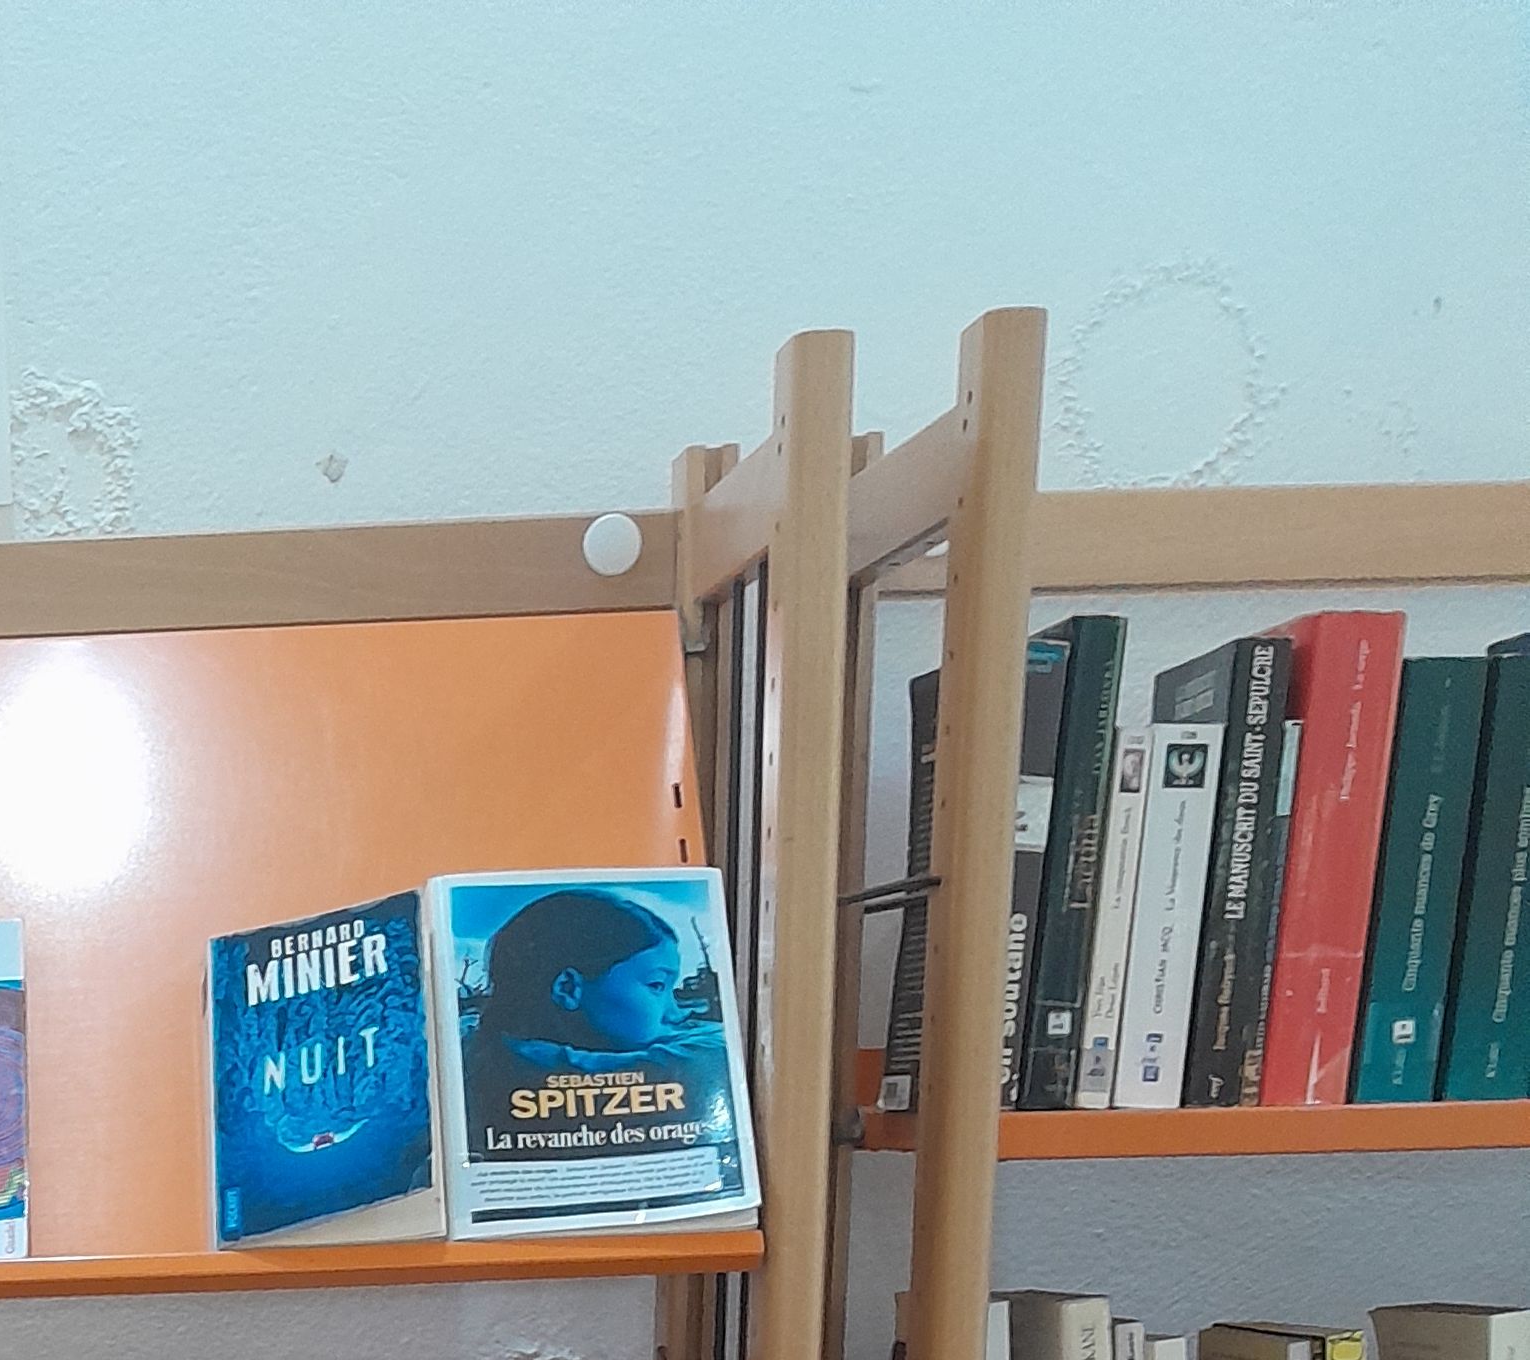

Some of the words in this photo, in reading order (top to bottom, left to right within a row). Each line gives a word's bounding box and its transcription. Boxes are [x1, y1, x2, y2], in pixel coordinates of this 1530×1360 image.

[1242, 777, 1260, 809] DU
[1227, 812, 1257, 895] MANUSCRIT
[1224, 893, 1245, 920] LE
[270, 919, 365, 958] BERNARD
[245, 933, 389, 1008] MINIER
[264, 1027, 380, 1096] NUIT
[511, 1083, 686, 1119] SPITZER
[487, 1127, 512, 1151] La
[517, 1124, 607, 1149] revanche
[610, 1122, 646, 1144] des
